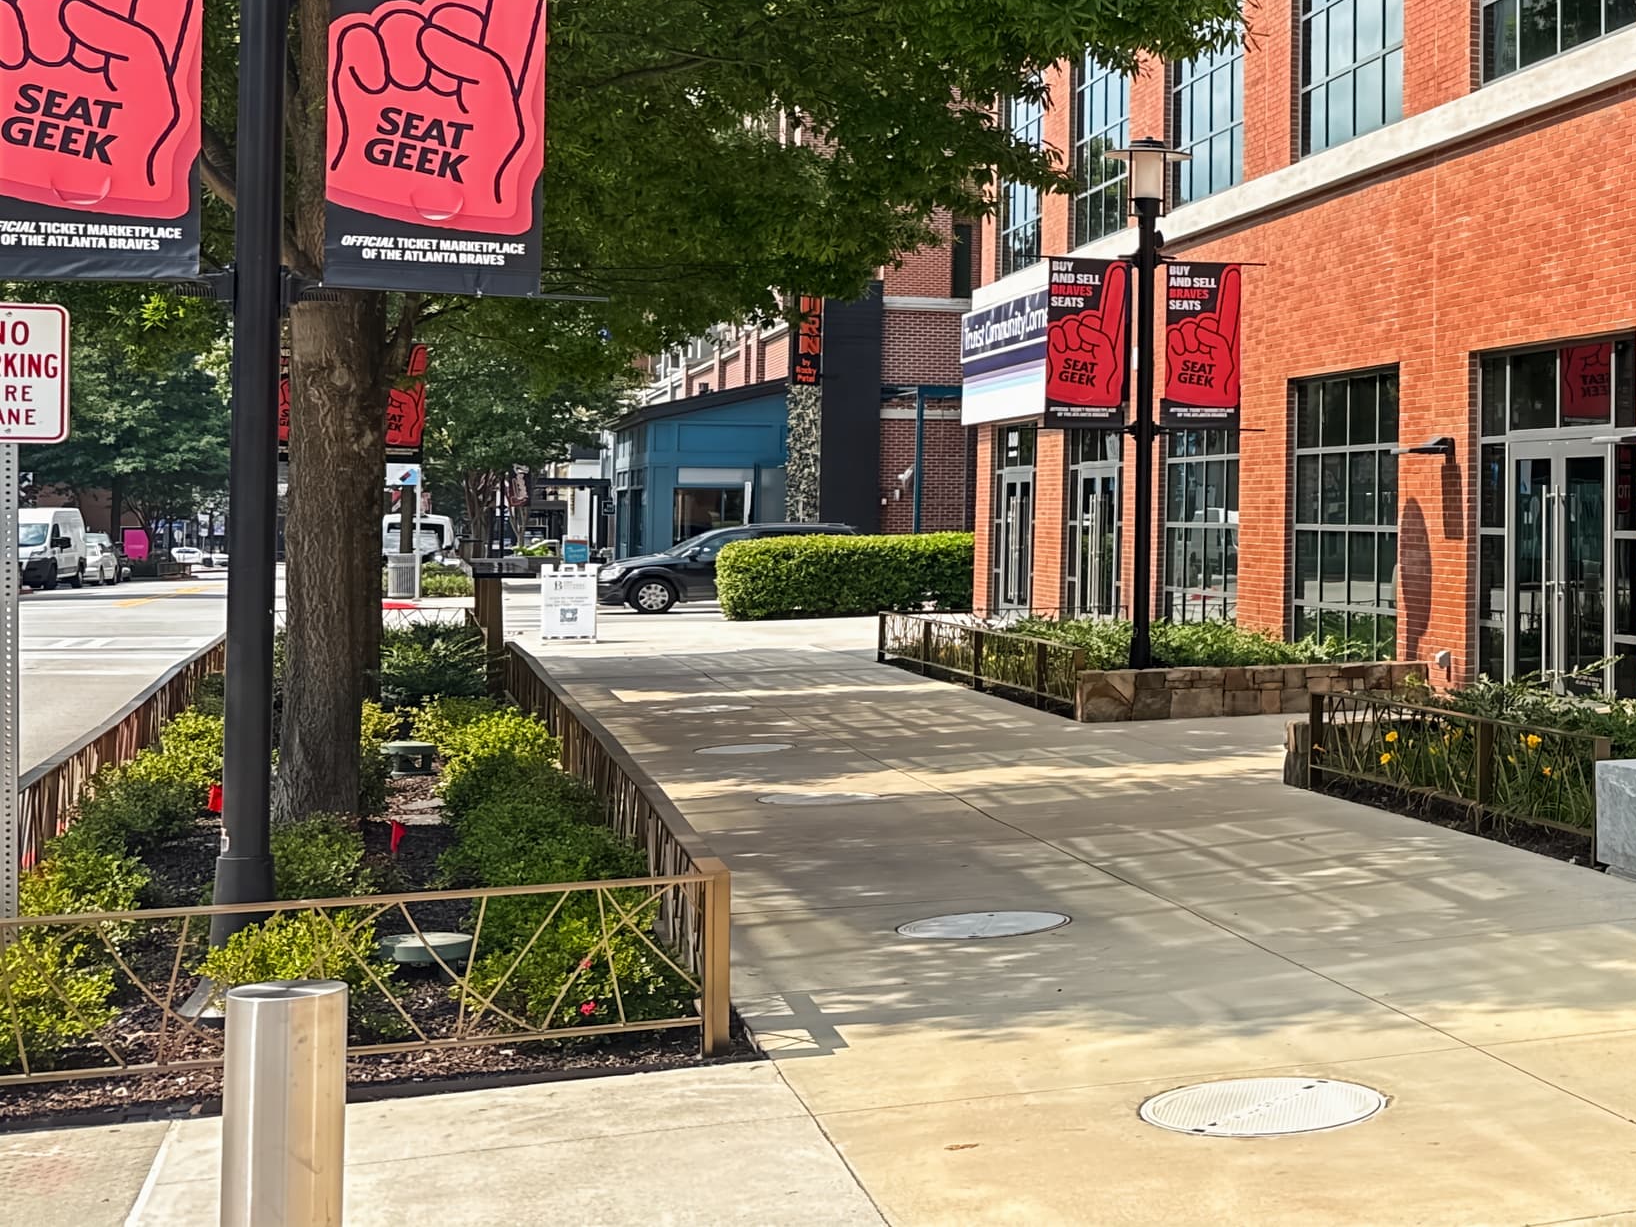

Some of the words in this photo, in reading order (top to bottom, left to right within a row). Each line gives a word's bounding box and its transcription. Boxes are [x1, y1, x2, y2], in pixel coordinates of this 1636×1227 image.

[15, 84, 123, 129] SEAT
[376, 106, 474, 150] SEAT
[1, 116, 119, 166] GEEK
[364, 138, 470, 184] GEEK
[0, 220, 36, 233] ICIAL
[39, 222, 85, 236] TICKET
[87, 224, 182, 239] MARKETPLACE
[1, 234, 19, 246] OF
[20, 234, 46, 247] THE
[47, 235, 107, 248] ATLANTA
[109, 238, 160, 251] BRAVES
[341, 234, 394, 248] OFFICIAL
[397, 237, 438, 251] TICKET
[440, 239, 525, 255] MARKETPLACE
[362, 248, 379, 260] OF
[379, 248, 402, 261] THE
[404, 250, 457, 264] ATLANTA
[459, 252, 505, 266] BRAVES
[1052, 260, 1074, 272] BUY
[1169, 265, 1191, 276] BUY
[1051, 272, 1075, 284] AND
[1076, 274, 1101, 285] SELL
[1169, 276, 1192, 287] AND
[1193, 277, 1217, 288] SELL
[1051, 284, 1093, 296] BRAVES
[1169, 287, 1209, 299] BRAVES
[1051, 296, 1084, 308] SEATS
[1169, 299, 1201, 311] SEATS
[964, 324, 985, 350] Truist
[985, 310, 1025, 346] Community
[0, 353, 58, 379] KING
[1062, 358, 1098, 374] SEAT
[1181, 360, 1216, 375] SEAT
[1058, 370, 1098, 388] GEEK
[1177, 372, 1215, 389] GEEK
[5, 384, 33, 402] RE
[0, 408, 36, 426] NE
